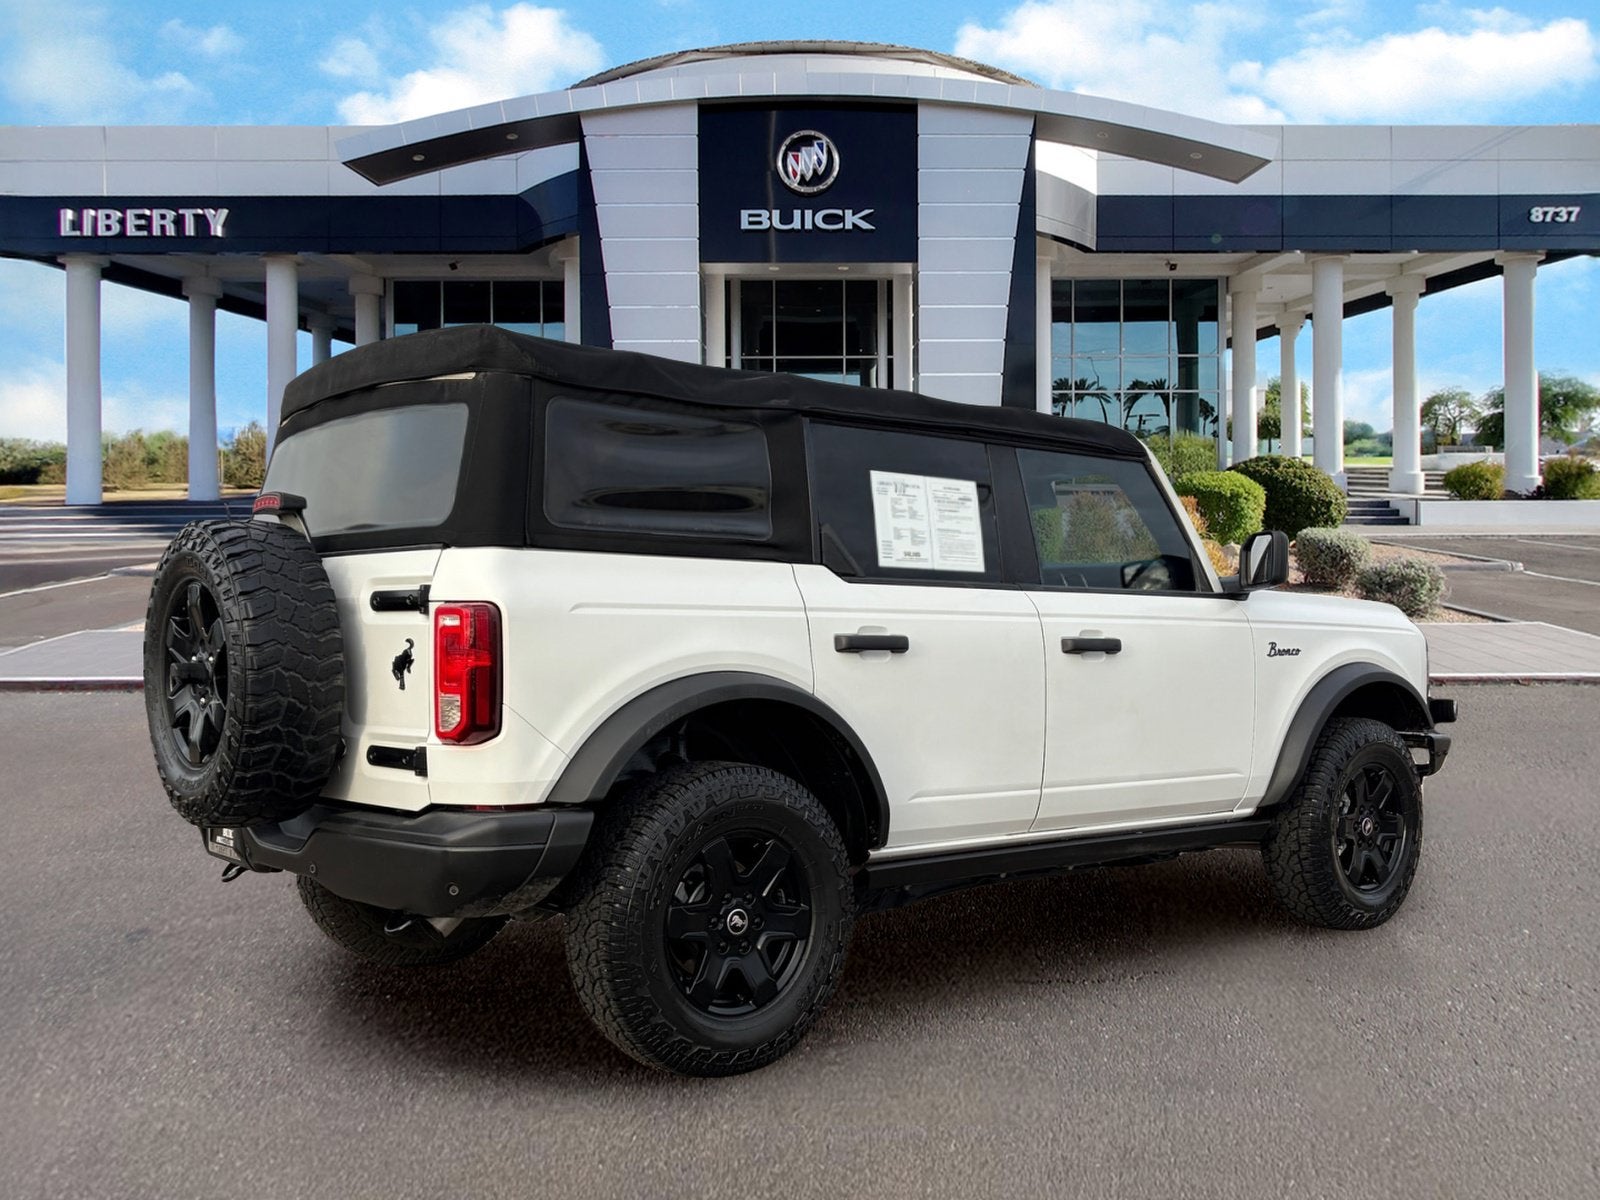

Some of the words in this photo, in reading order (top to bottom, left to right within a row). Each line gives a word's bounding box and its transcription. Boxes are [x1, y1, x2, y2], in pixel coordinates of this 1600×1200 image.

[59, 208, 229, 237] LIBERTY
[740, 209, 876, 230] BUICK
[1529, 206, 1581, 222] 8737
[1266, 641, 1302, 657] Bronco
